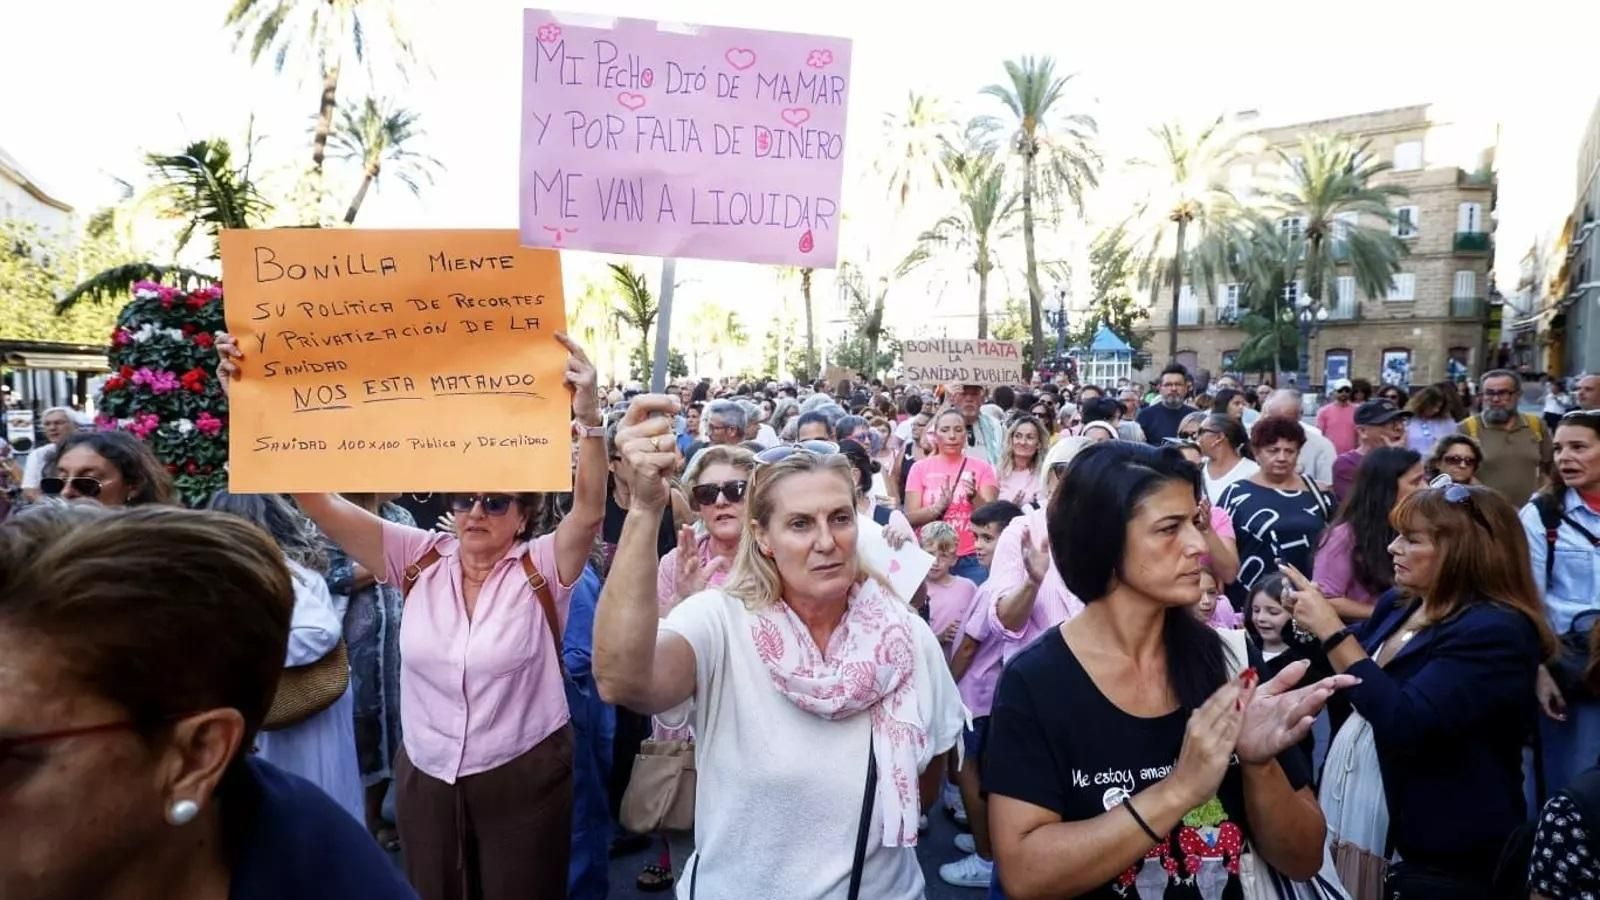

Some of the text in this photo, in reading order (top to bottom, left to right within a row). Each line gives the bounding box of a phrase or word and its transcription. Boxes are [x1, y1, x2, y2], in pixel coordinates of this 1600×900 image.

[535, 36, 845, 105] MI PECHO DIÓ DE MAMAR
[533, 110, 843, 160] Y POR FALTA DE DINERO
[533, 169, 837, 231] ME VAN A LIQUIDAR
[428, 251, 514, 273] MIENTE
[252, 302, 286, 320] SU
[406, 298, 440, 312] DE
[448, 293, 545, 309] RECORTES
[256, 332, 266, 353] Y
[459, 320, 495, 334] DE
[510, 315, 539, 331] LA
[906, 339, 1018, 358] BONILLA MATA
[948, 354, 962, 363] LA
[293, 374, 535, 409] NOS ESTA MATANDO
[1072, 757, 1177, 793] Me estoy aman
